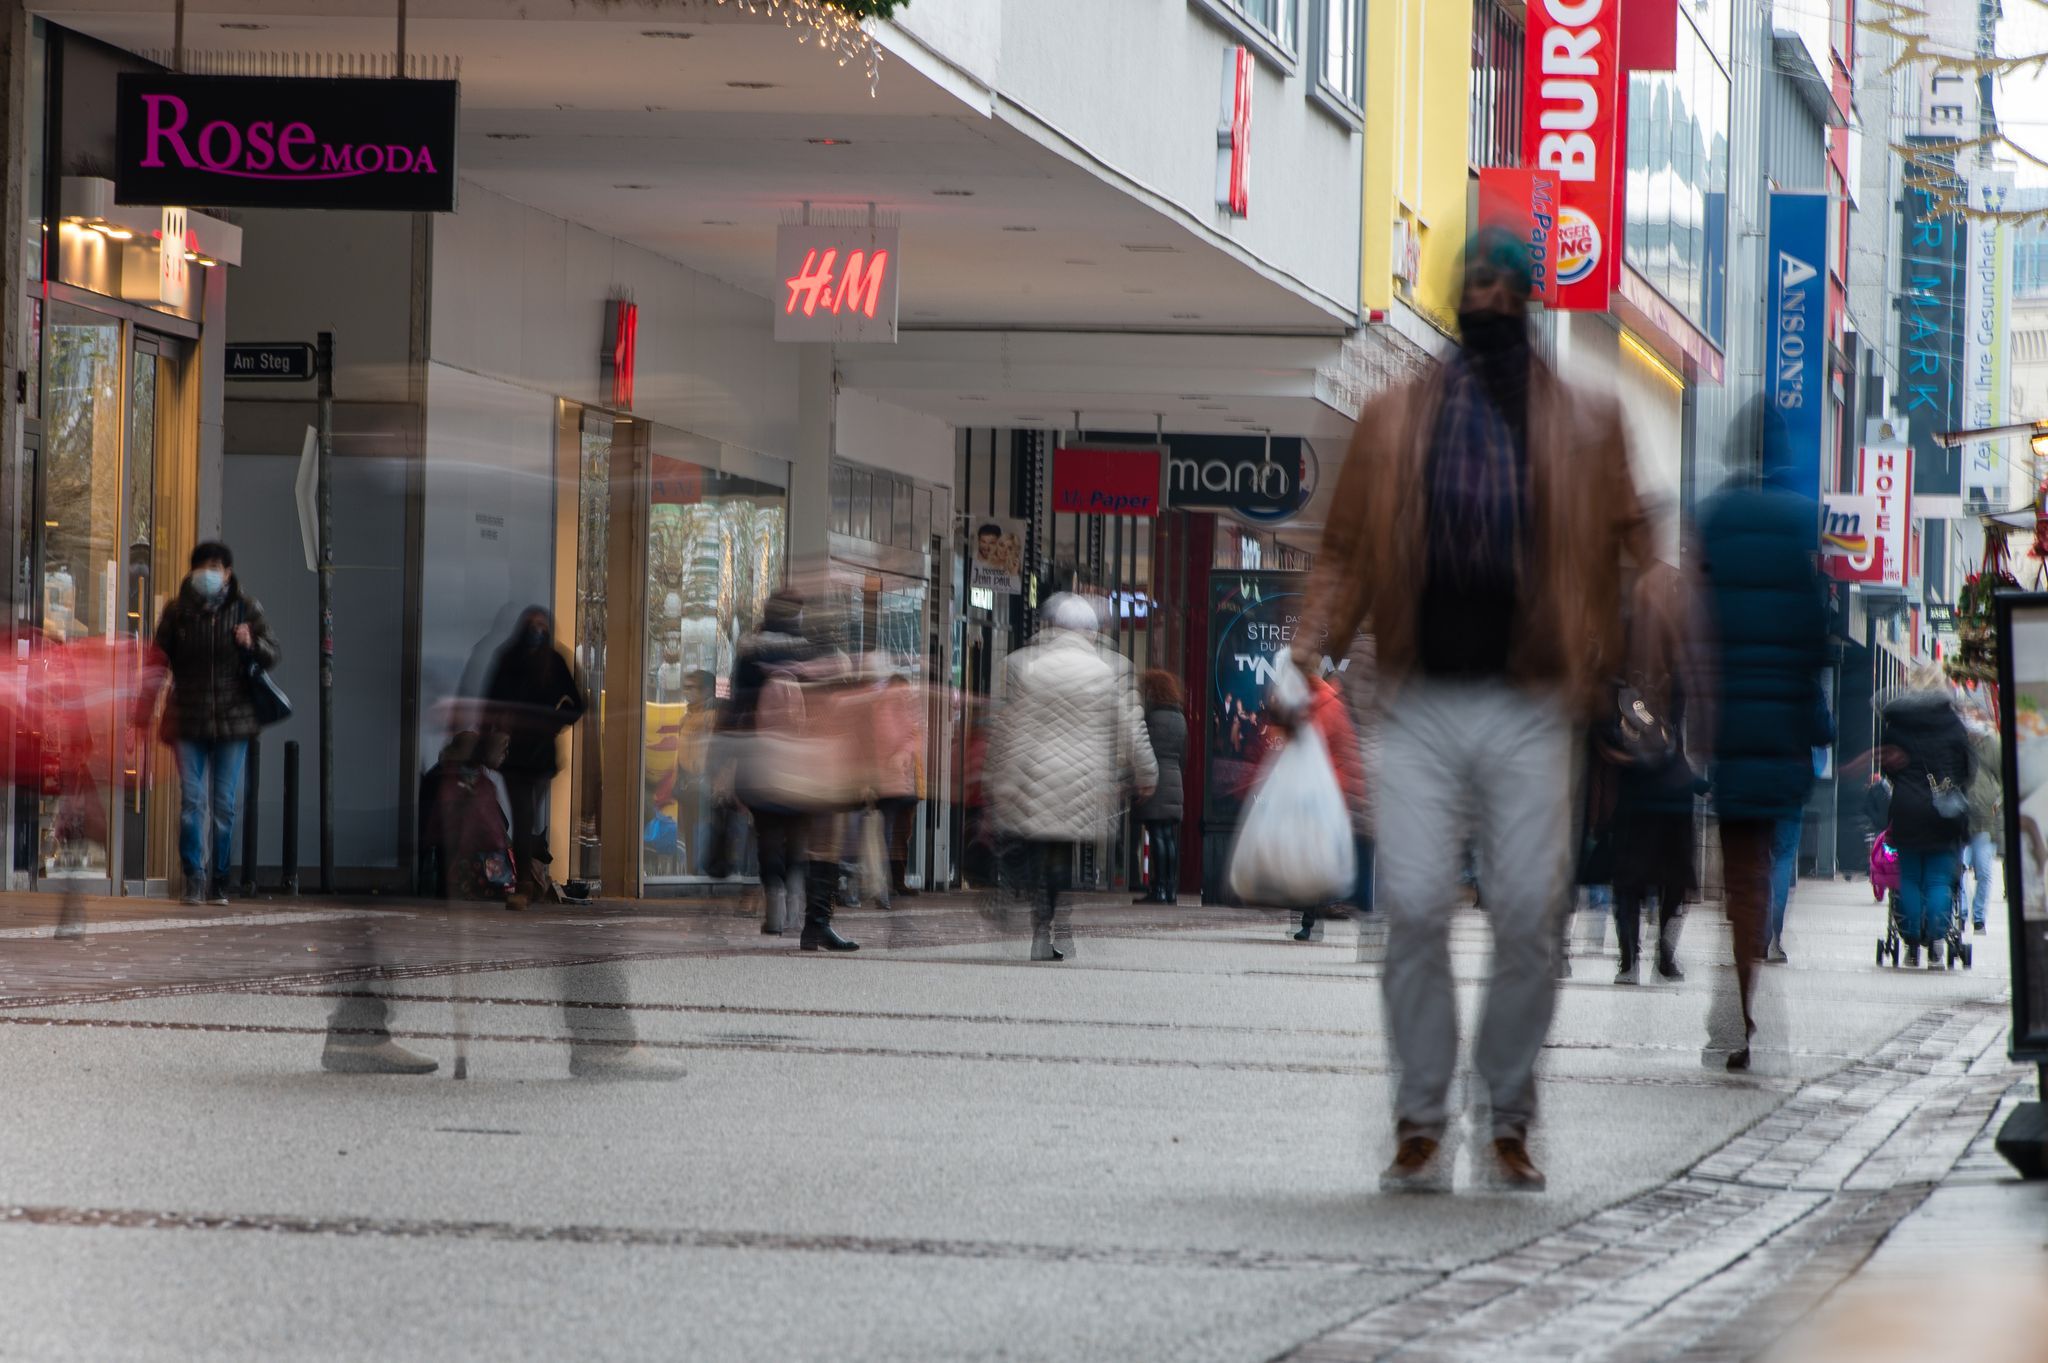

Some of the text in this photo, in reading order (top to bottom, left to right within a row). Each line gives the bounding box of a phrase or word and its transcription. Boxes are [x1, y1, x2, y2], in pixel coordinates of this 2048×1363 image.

[320, 144, 438, 173] MODA
[1558, 225, 1591, 241] RGER
[1560, 237, 1592, 259] NG
[785, 247, 889, 319] H&M
[233, 353, 290, 373] Am Steg
[1975, 353, 1993, 392] Ihre
[1974, 437, 1991, 471] Zei
[1169, 459, 1287, 494] mann
[1876, 454, 1894, 545] HOTE
